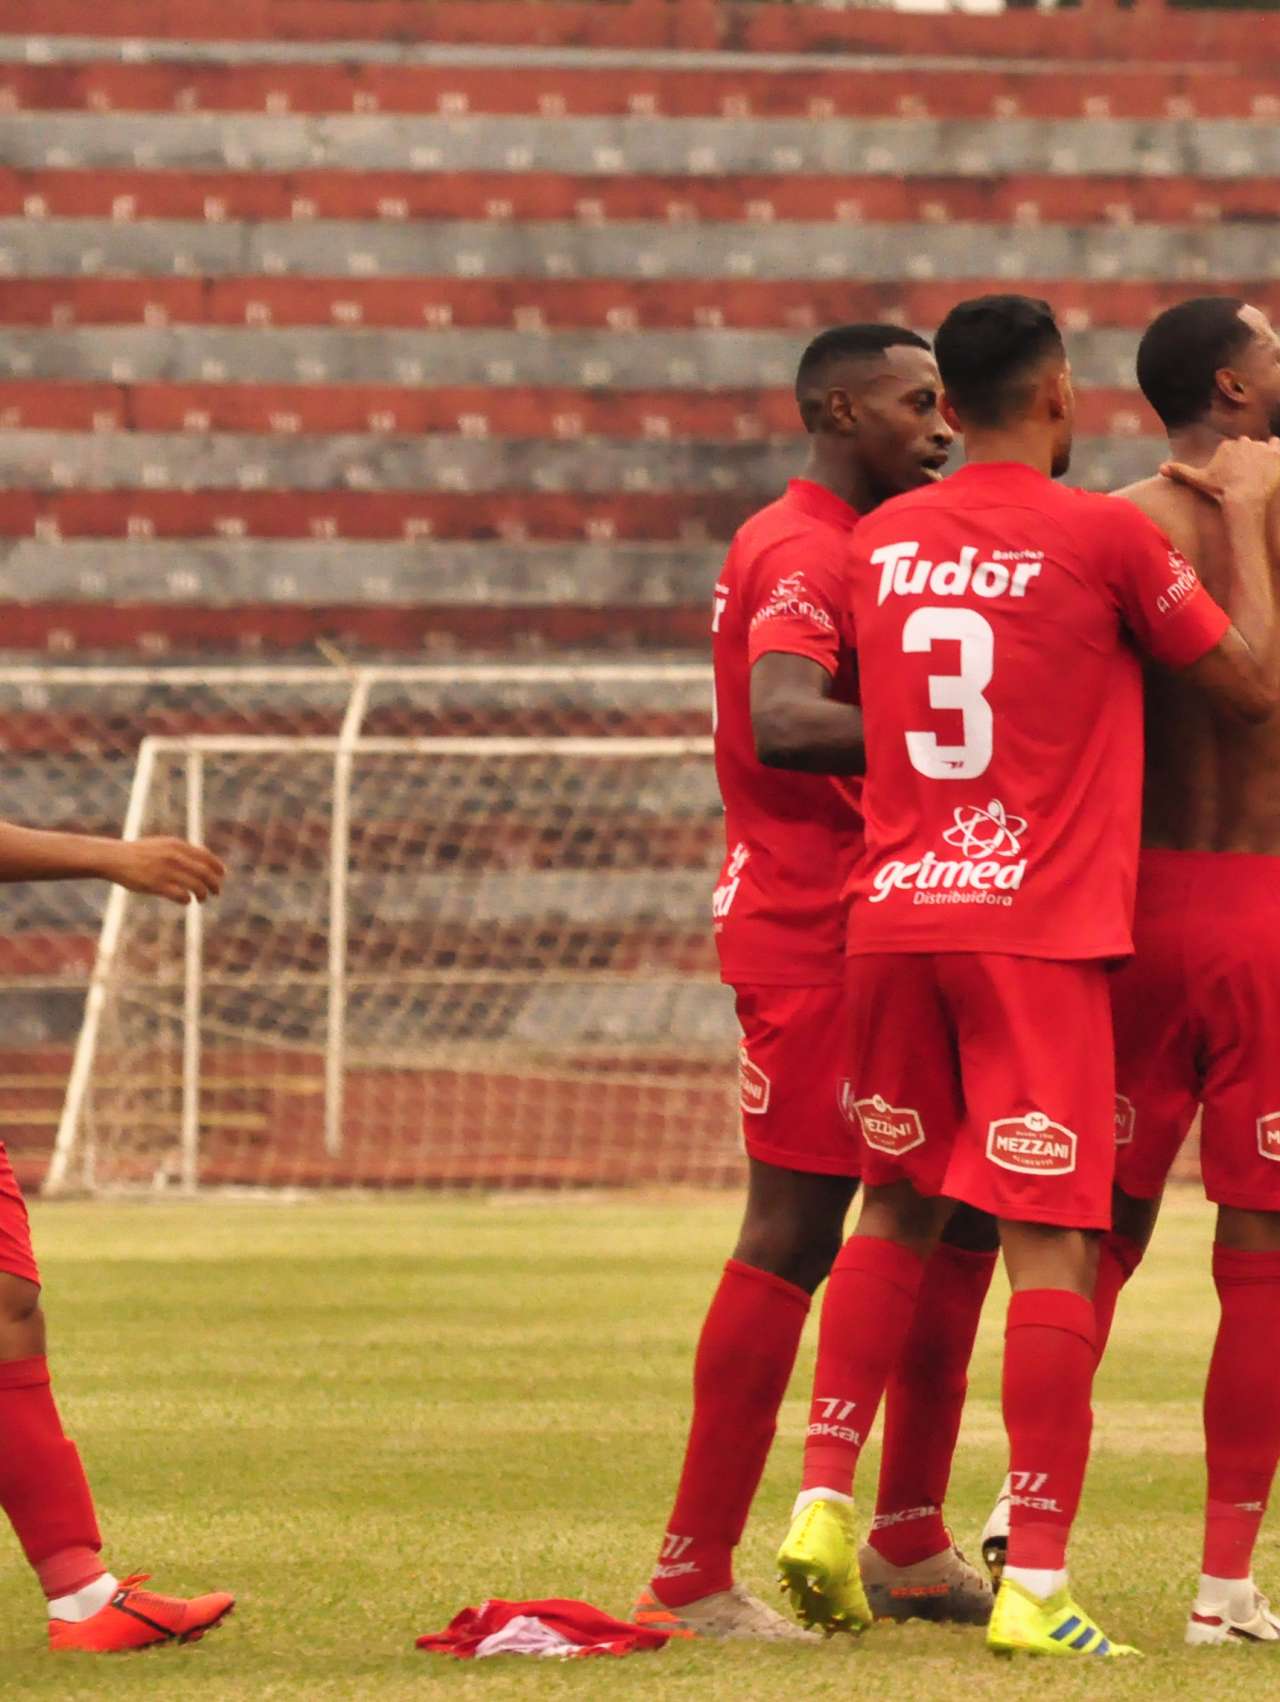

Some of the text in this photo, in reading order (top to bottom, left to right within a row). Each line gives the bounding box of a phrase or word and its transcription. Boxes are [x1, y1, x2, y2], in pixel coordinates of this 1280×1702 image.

[869, 540, 1043, 608] Tudor
[902, 606, 994, 780] 3
[867, 851, 1029, 903] getmed
[912, 890, 1013, 907] Distribuidora
[995, 1135, 1070, 1159] MEZZANI
